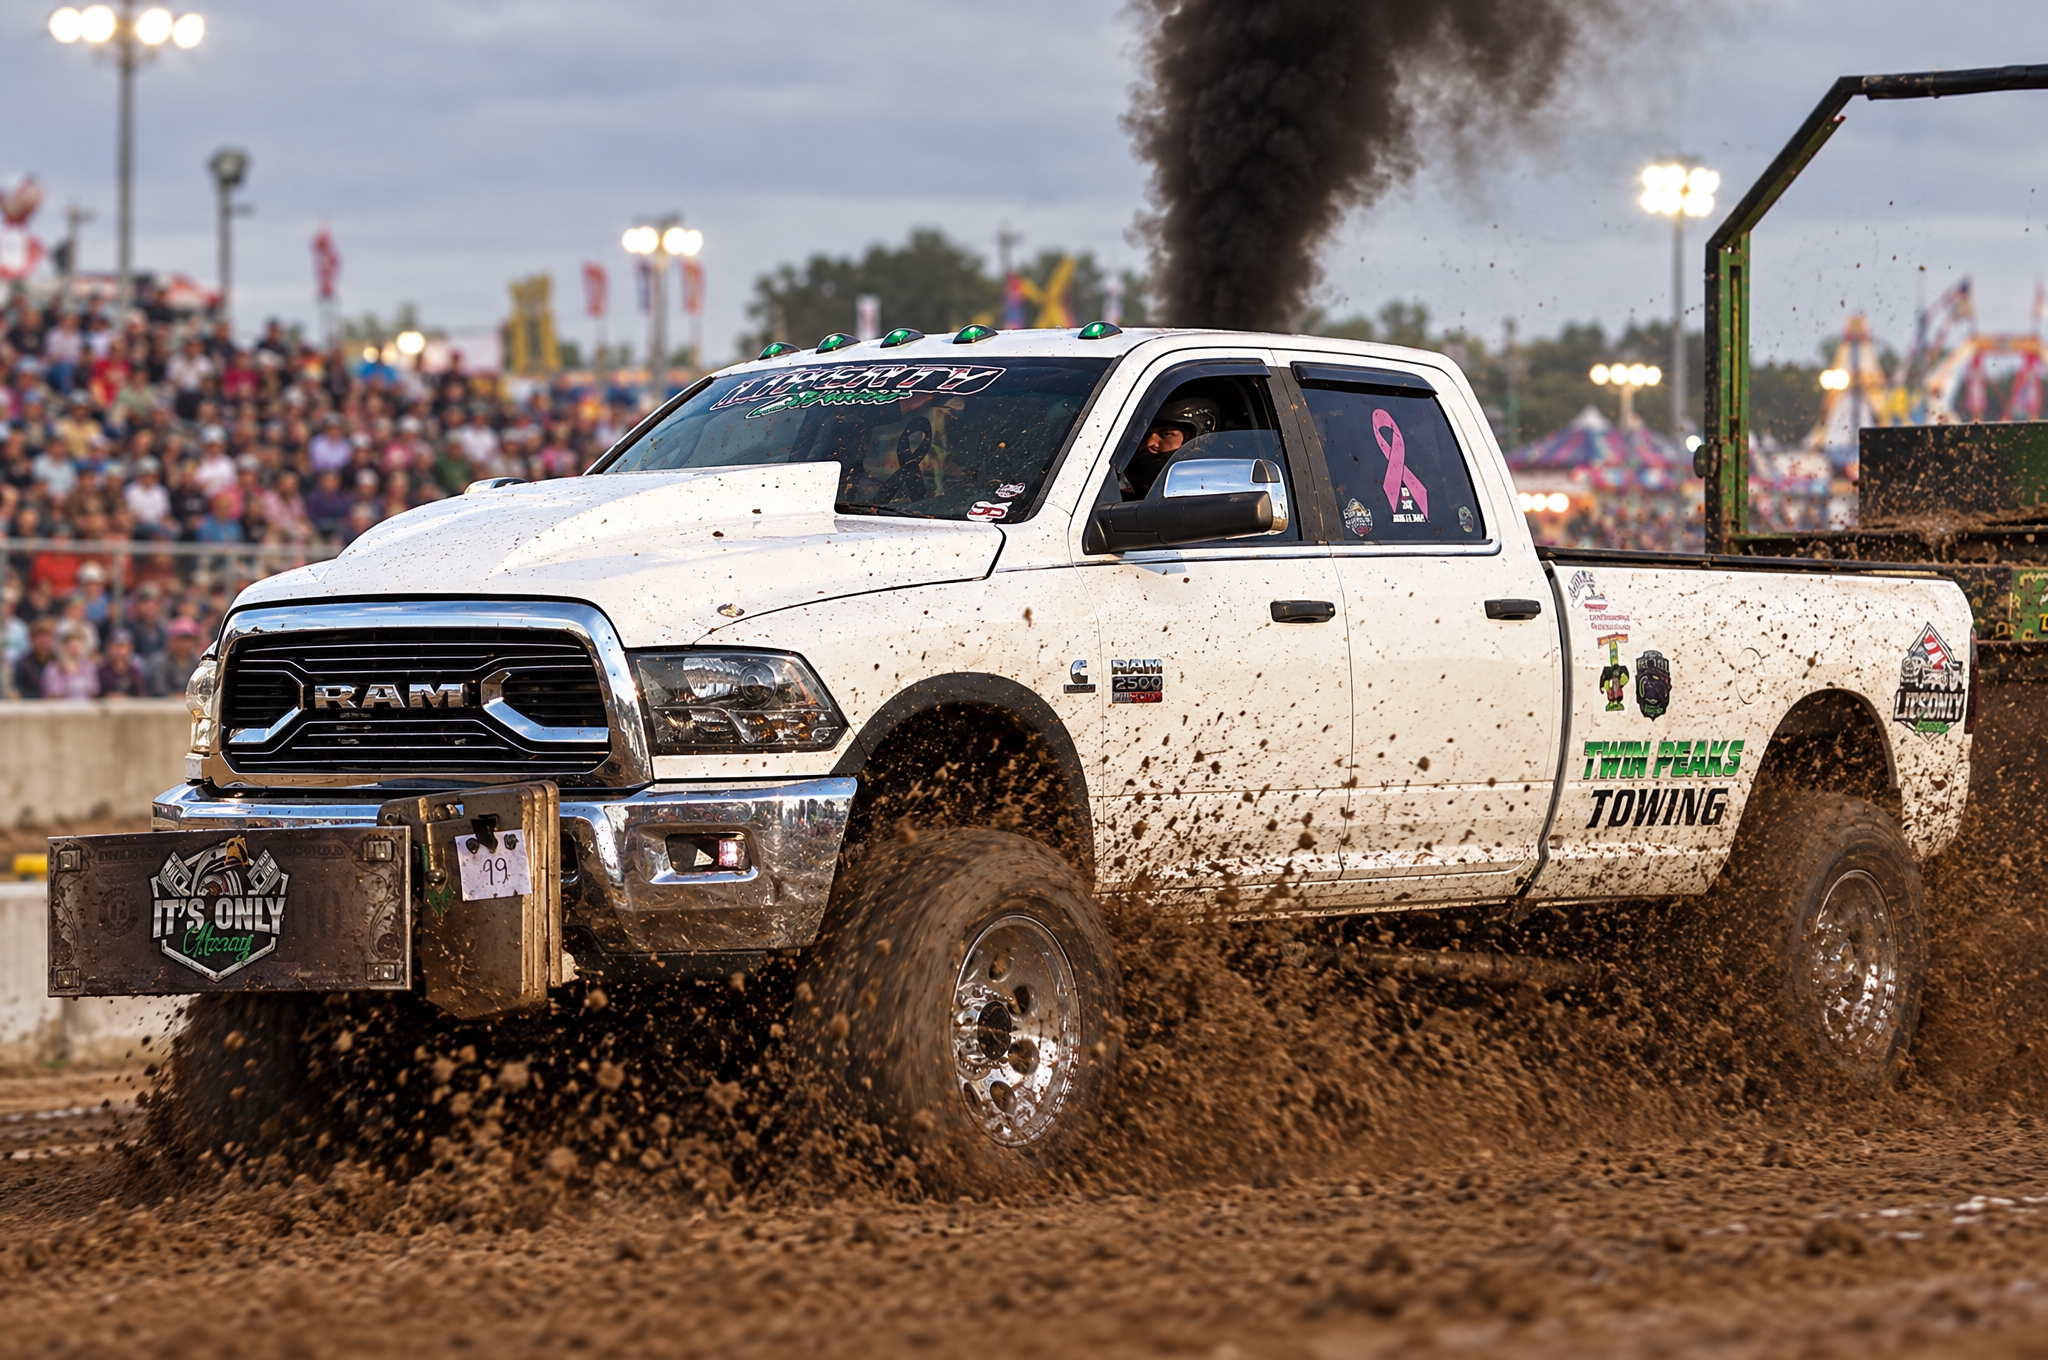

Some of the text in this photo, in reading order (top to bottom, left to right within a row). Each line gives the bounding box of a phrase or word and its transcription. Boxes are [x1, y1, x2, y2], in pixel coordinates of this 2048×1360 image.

[1111, 659, 1162, 675] RAM
[315, 683, 466, 709] RAM
[1115, 677, 1161, 690] 2500
[1583, 740, 1745, 779] TWIN PEAKS
[1585, 788, 1728, 828] TOWING
[483, 857, 508, 886] 99
[153, 898, 205, 938] IT'S
[215, 897, 287, 935] ONLY
